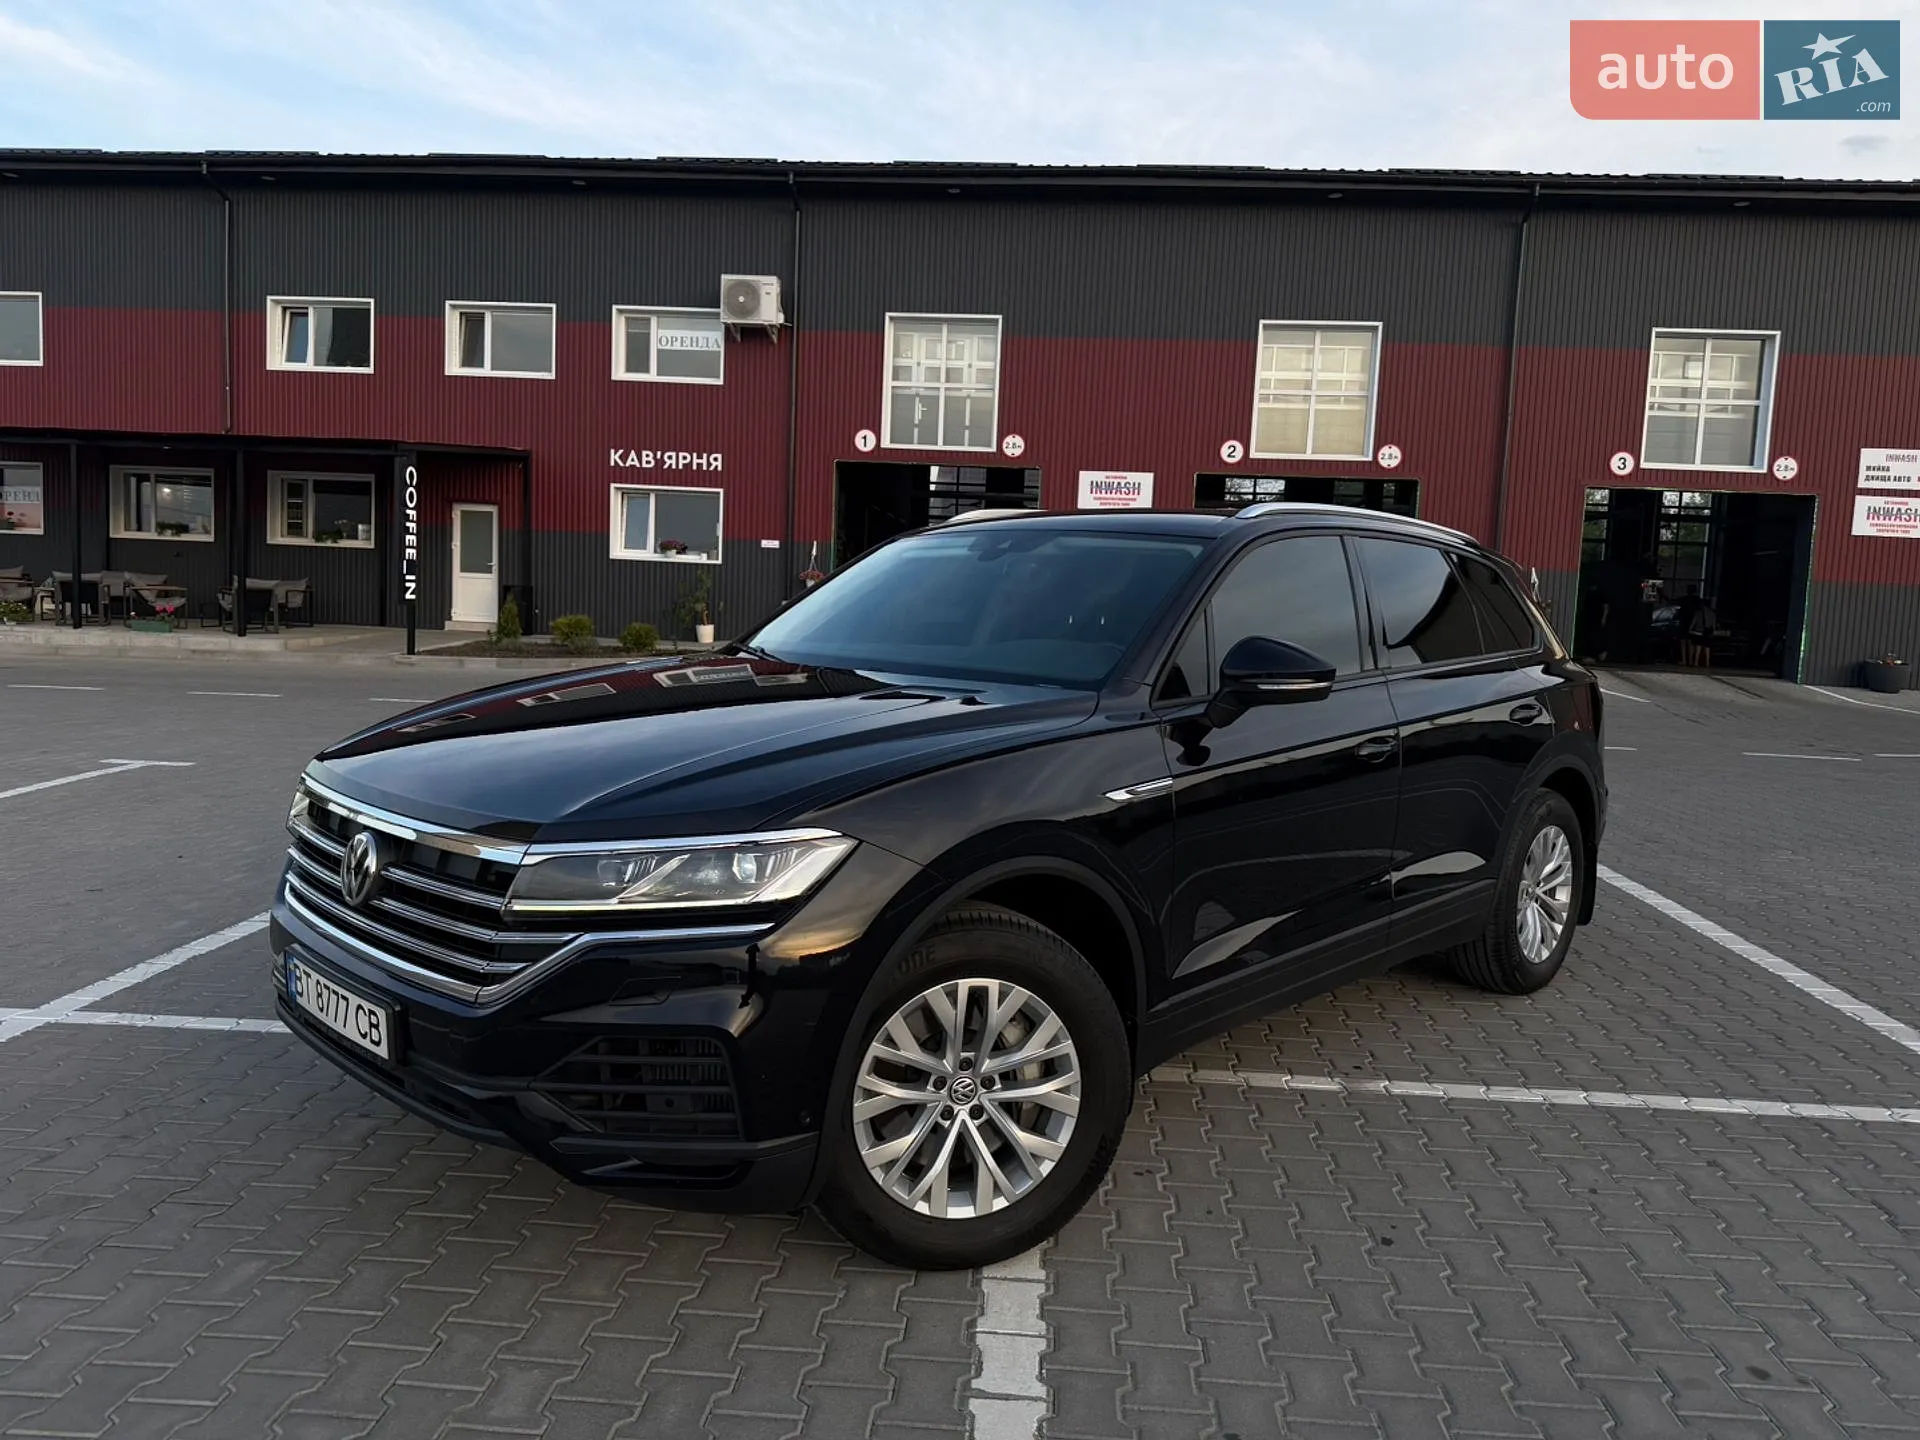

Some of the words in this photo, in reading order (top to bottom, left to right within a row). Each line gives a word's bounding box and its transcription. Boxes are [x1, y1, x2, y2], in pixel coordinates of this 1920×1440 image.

[658, 335, 721, 350] ОРЕНДА
[861, 434, 868, 448] 1
[1226, 444, 1236, 459] 2
[1885, 453, 1918, 463] INWASH
[609, 448, 723, 471] КАВ'ЯРНЯ
[1617, 457, 1627, 471] 3
[1089, 480, 1142, 496] INWASH
[295, 963, 312, 1005] BT
[315, 979, 350, 1029] 8777
[355, 1003, 382, 1048] CB
